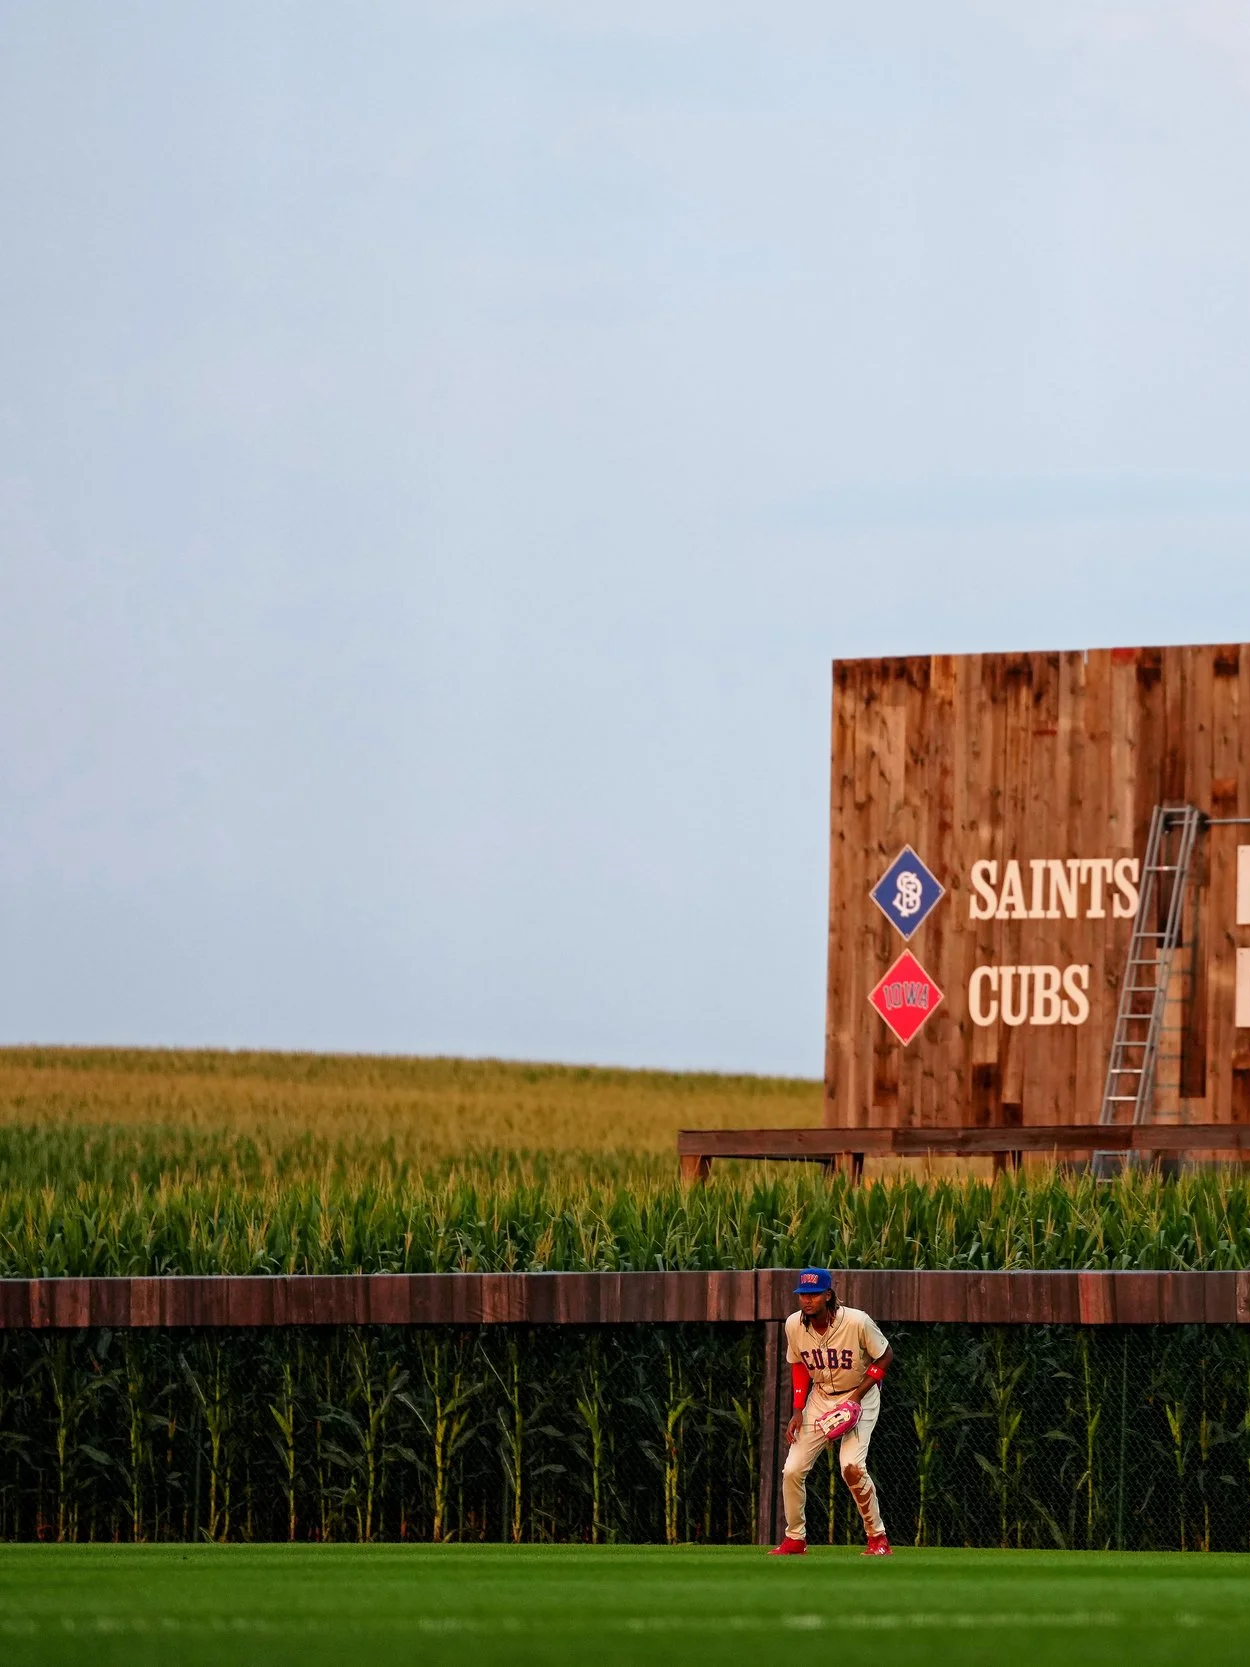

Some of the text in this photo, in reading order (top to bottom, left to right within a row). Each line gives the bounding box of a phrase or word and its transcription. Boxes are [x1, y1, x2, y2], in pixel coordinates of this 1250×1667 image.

[969, 858, 1140, 920] SAINTS
[882, 982, 930, 1010] IOWA
[968, 964, 1090, 1027] CUBS
[801, 1348, 853, 1370] CUBS
